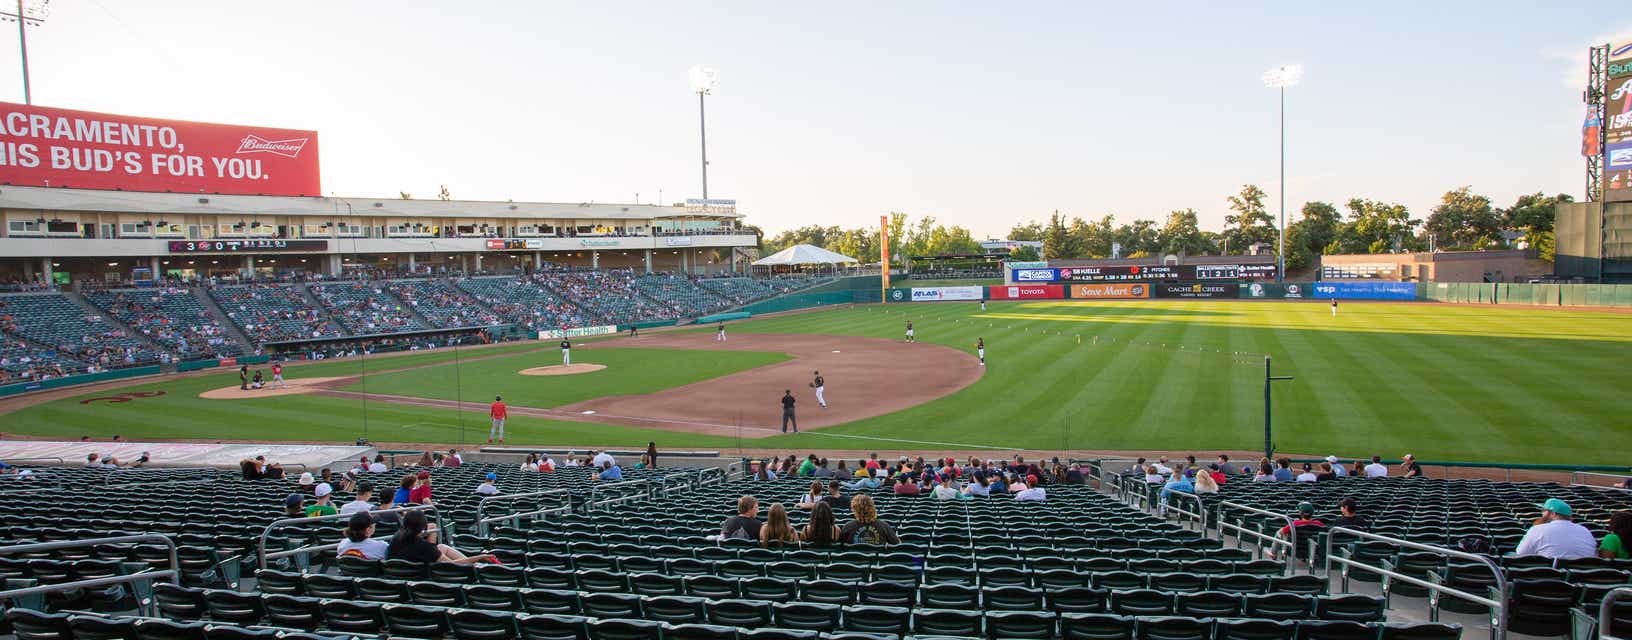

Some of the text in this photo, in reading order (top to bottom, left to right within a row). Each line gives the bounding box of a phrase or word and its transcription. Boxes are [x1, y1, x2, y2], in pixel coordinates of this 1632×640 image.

[242, 138, 302, 152] Budweiser
[51, 146, 142, 174] BUD'S
[152, 153, 204, 177] FOR
[212, 157, 269, 180] YOU.
[187, 242, 195, 251] 3
[216, 242, 223, 250] 0
[1081, 286, 1128, 296] Save Mart
[1316, 286, 1336, 294] vsp
[557, 328, 581, 338] Stter
